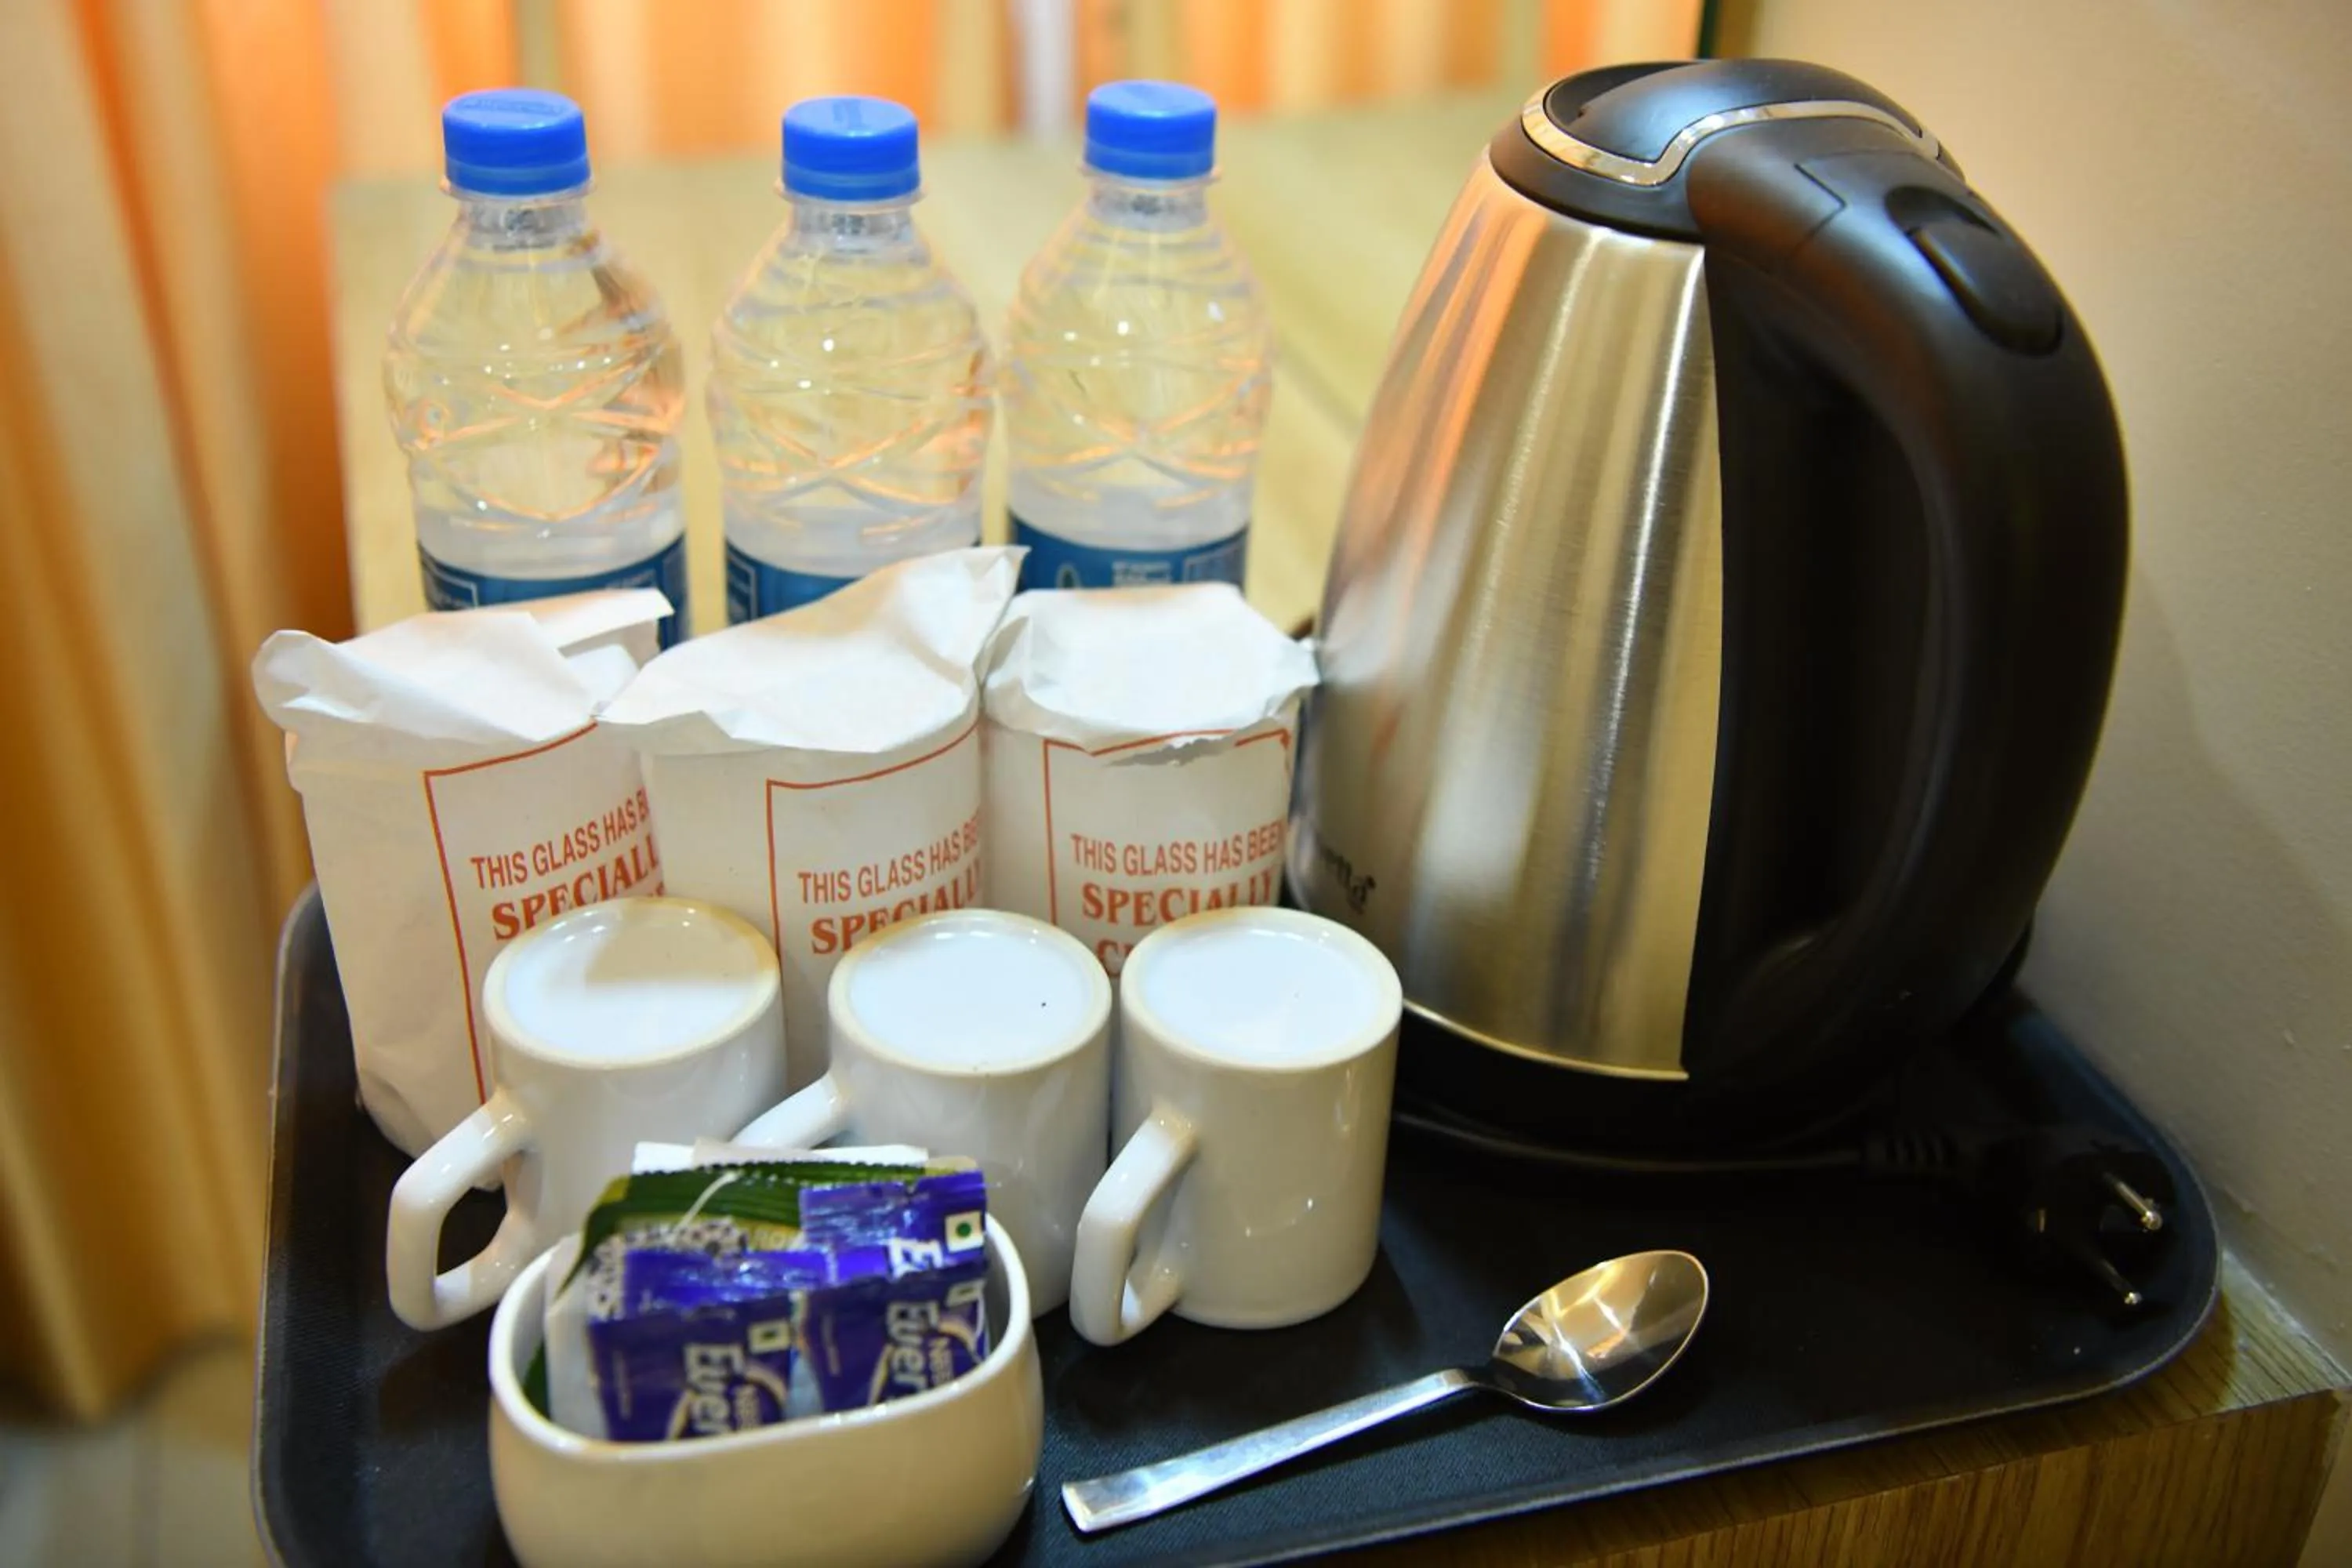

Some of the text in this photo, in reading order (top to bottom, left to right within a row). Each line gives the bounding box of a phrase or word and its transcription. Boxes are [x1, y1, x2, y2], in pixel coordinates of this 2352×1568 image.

[470, 851, 528, 890] THIS
[532, 822, 601, 877] GLASS
[602, 798, 637, 845] HAS
[798, 870, 851, 903] THIS
[858, 850, 926, 898] GLASS
[929, 829, 961, 876] HAS
[1070, 833, 1116, 874] THIS
[1123, 841, 1197, 877] GLASS
[1203, 834, 1243, 874] HAS
[492, 833, 660, 942] SPECIALL
